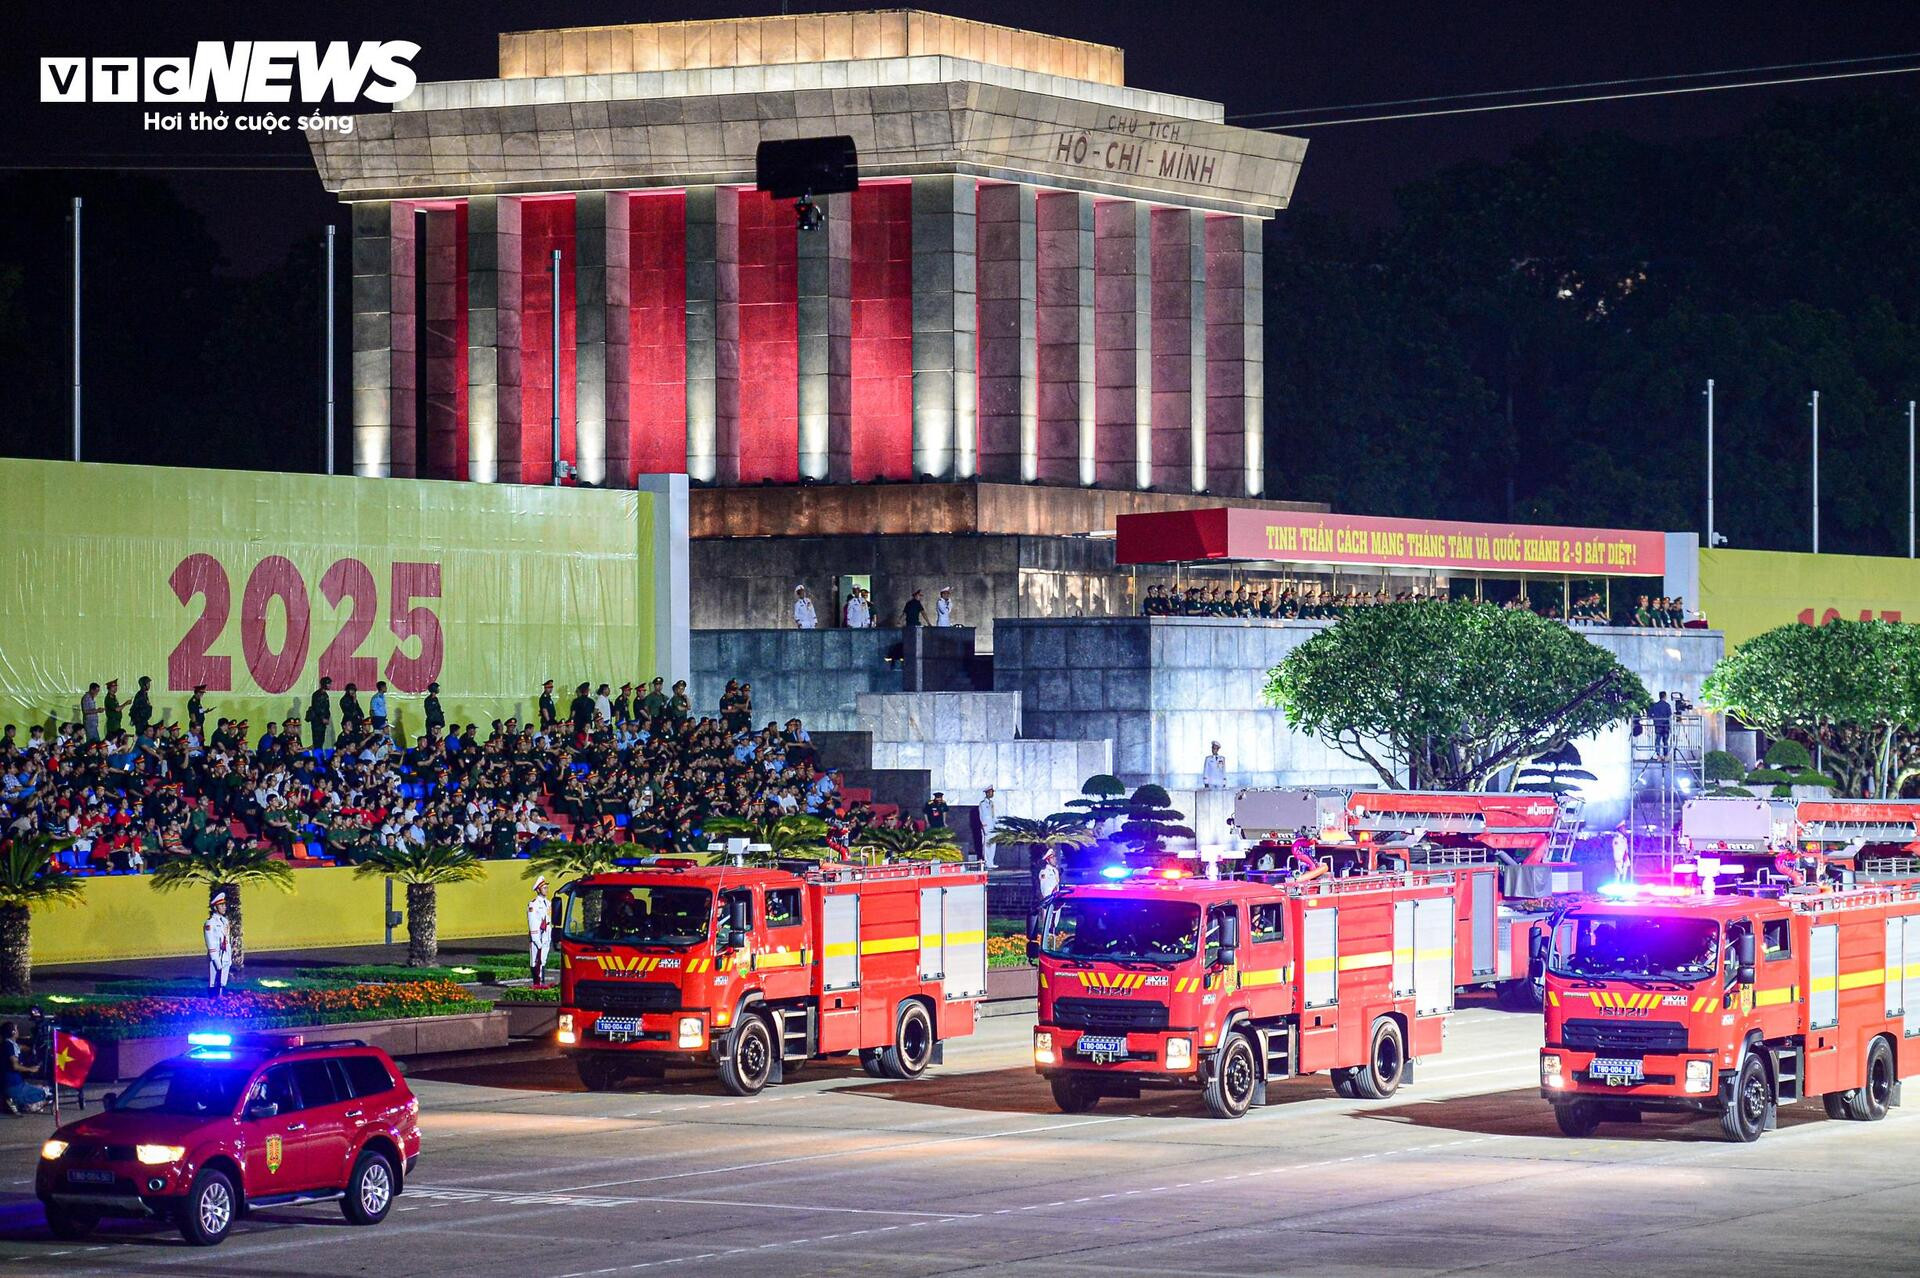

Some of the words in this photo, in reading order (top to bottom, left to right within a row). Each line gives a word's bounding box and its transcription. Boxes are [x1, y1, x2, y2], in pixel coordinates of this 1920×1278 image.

[1158, 145, 1216, 184] MINH
[1266, 525, 1298, 551] TINH
[1300, 520, 1334, 553] THẦN
[1337, 525, 1368, 554] CÁCH
[1371, 531, 1404, 561] MẠNG
[1407, 530, 1446, 558] THÁNG
[1448, 531, 1473, 560] TÁM
[1475, 533, 1490, 560] VÀ
[1493, 532, 1521, 562] QUỐC
[1523, 535, 1560, 563] KHÁNH
[1563, 541, 1583, 564] 2-9
[1585, 536, 1606, 565] BẤT
[1608, 539, 1637, 570] DIỆT!
[168, 552, 444, 694] 2025
[1706, 841, 1755, 850] MORITA
[1599, 1006, 1648, 1017] ISUZU
